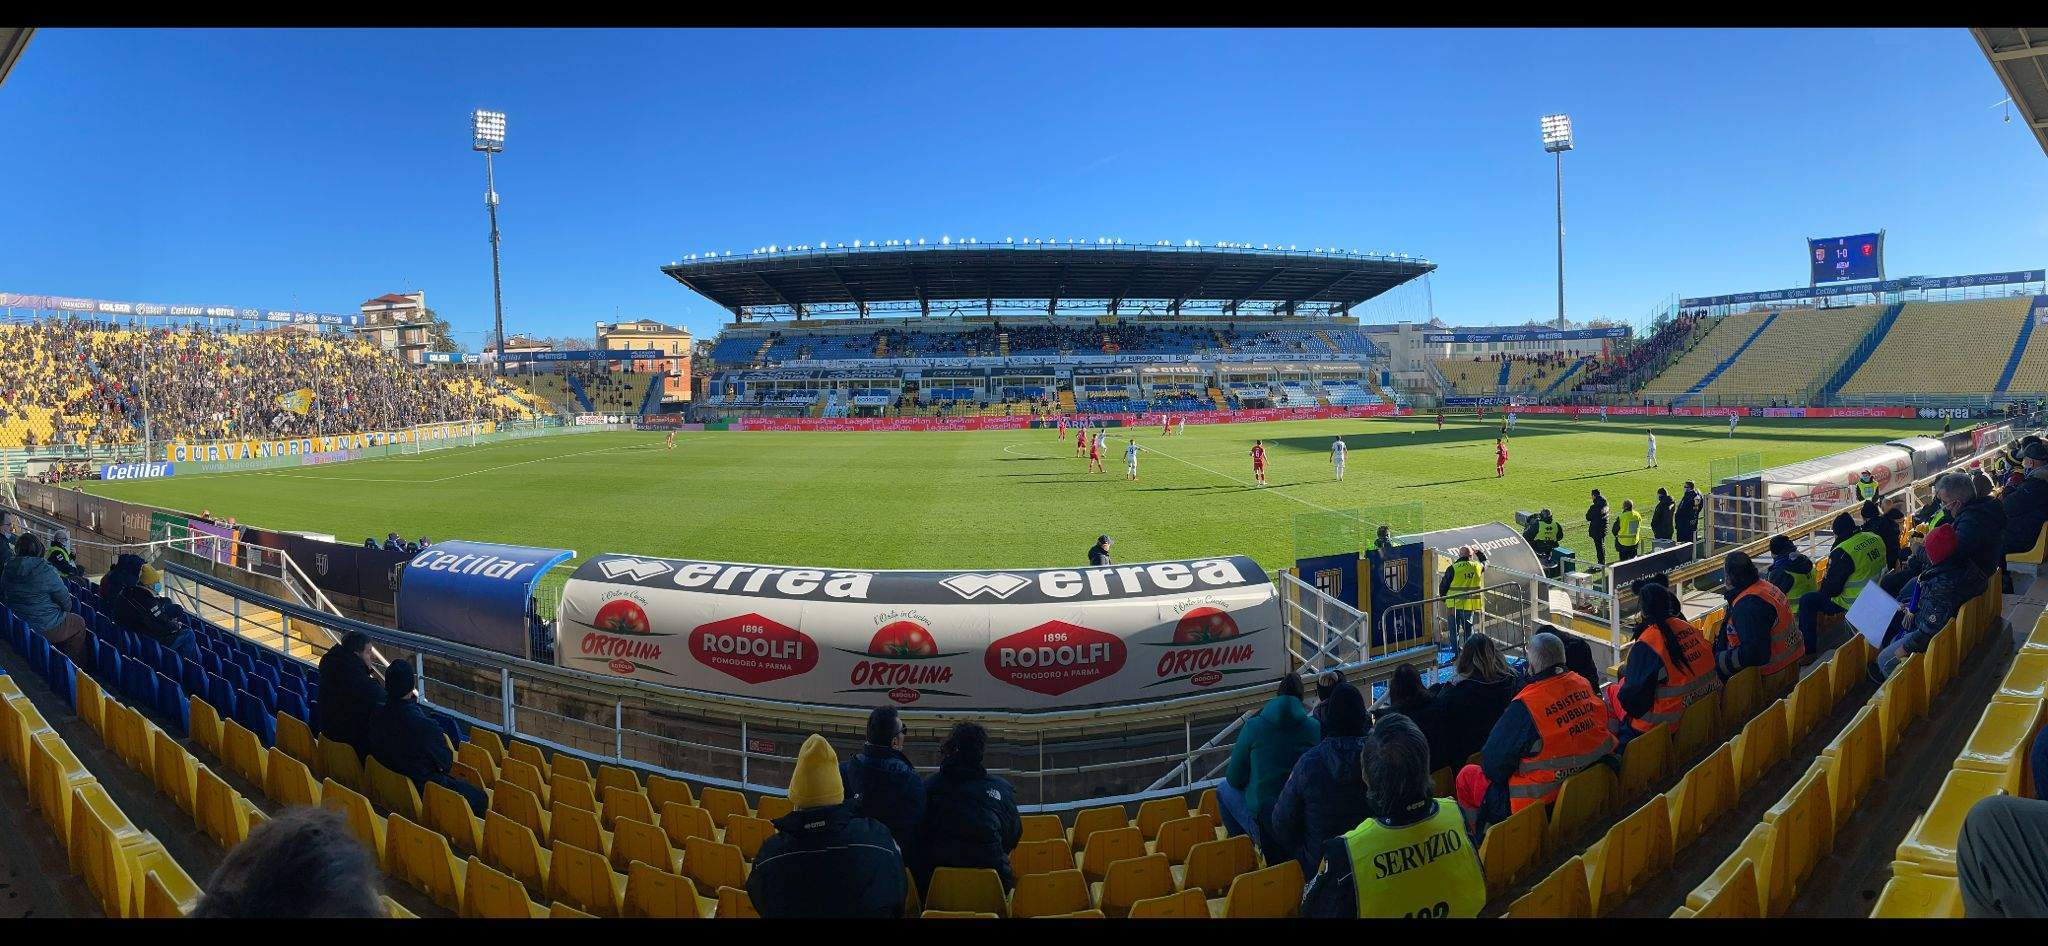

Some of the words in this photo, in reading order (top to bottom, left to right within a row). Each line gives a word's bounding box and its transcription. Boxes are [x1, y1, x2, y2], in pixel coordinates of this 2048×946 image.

[1833, 407, 1886, 417] LeasePlan
[261, 438, 311, 458] NORD
[411, 548, 538, 580] Cetilar
[1038, 556, 1247, 598] errea
[674, 559, 871, 600] errea
[742, 624, 764, 634] 1896
[1043, 633, 1068, 643] 1896
[580, 631, 662, 660] ORTOLINA
[703, 633, 802, 660] RODOLFI
[1000, 642, 1111, 668] RODOLFI
[711, 656, 757, 668] POMODORO
[765, 662, 793, 671] PARMA
[850, 660, 954, 686] ORTOLINA
[1156, 643, 1255, 678] ORTOLINA
[1011, 670, 1062, 680] POMODORO
[1071, 668, 1100, 677] PARMA
[1373, 829, 1462, 880] SERVIZIO
